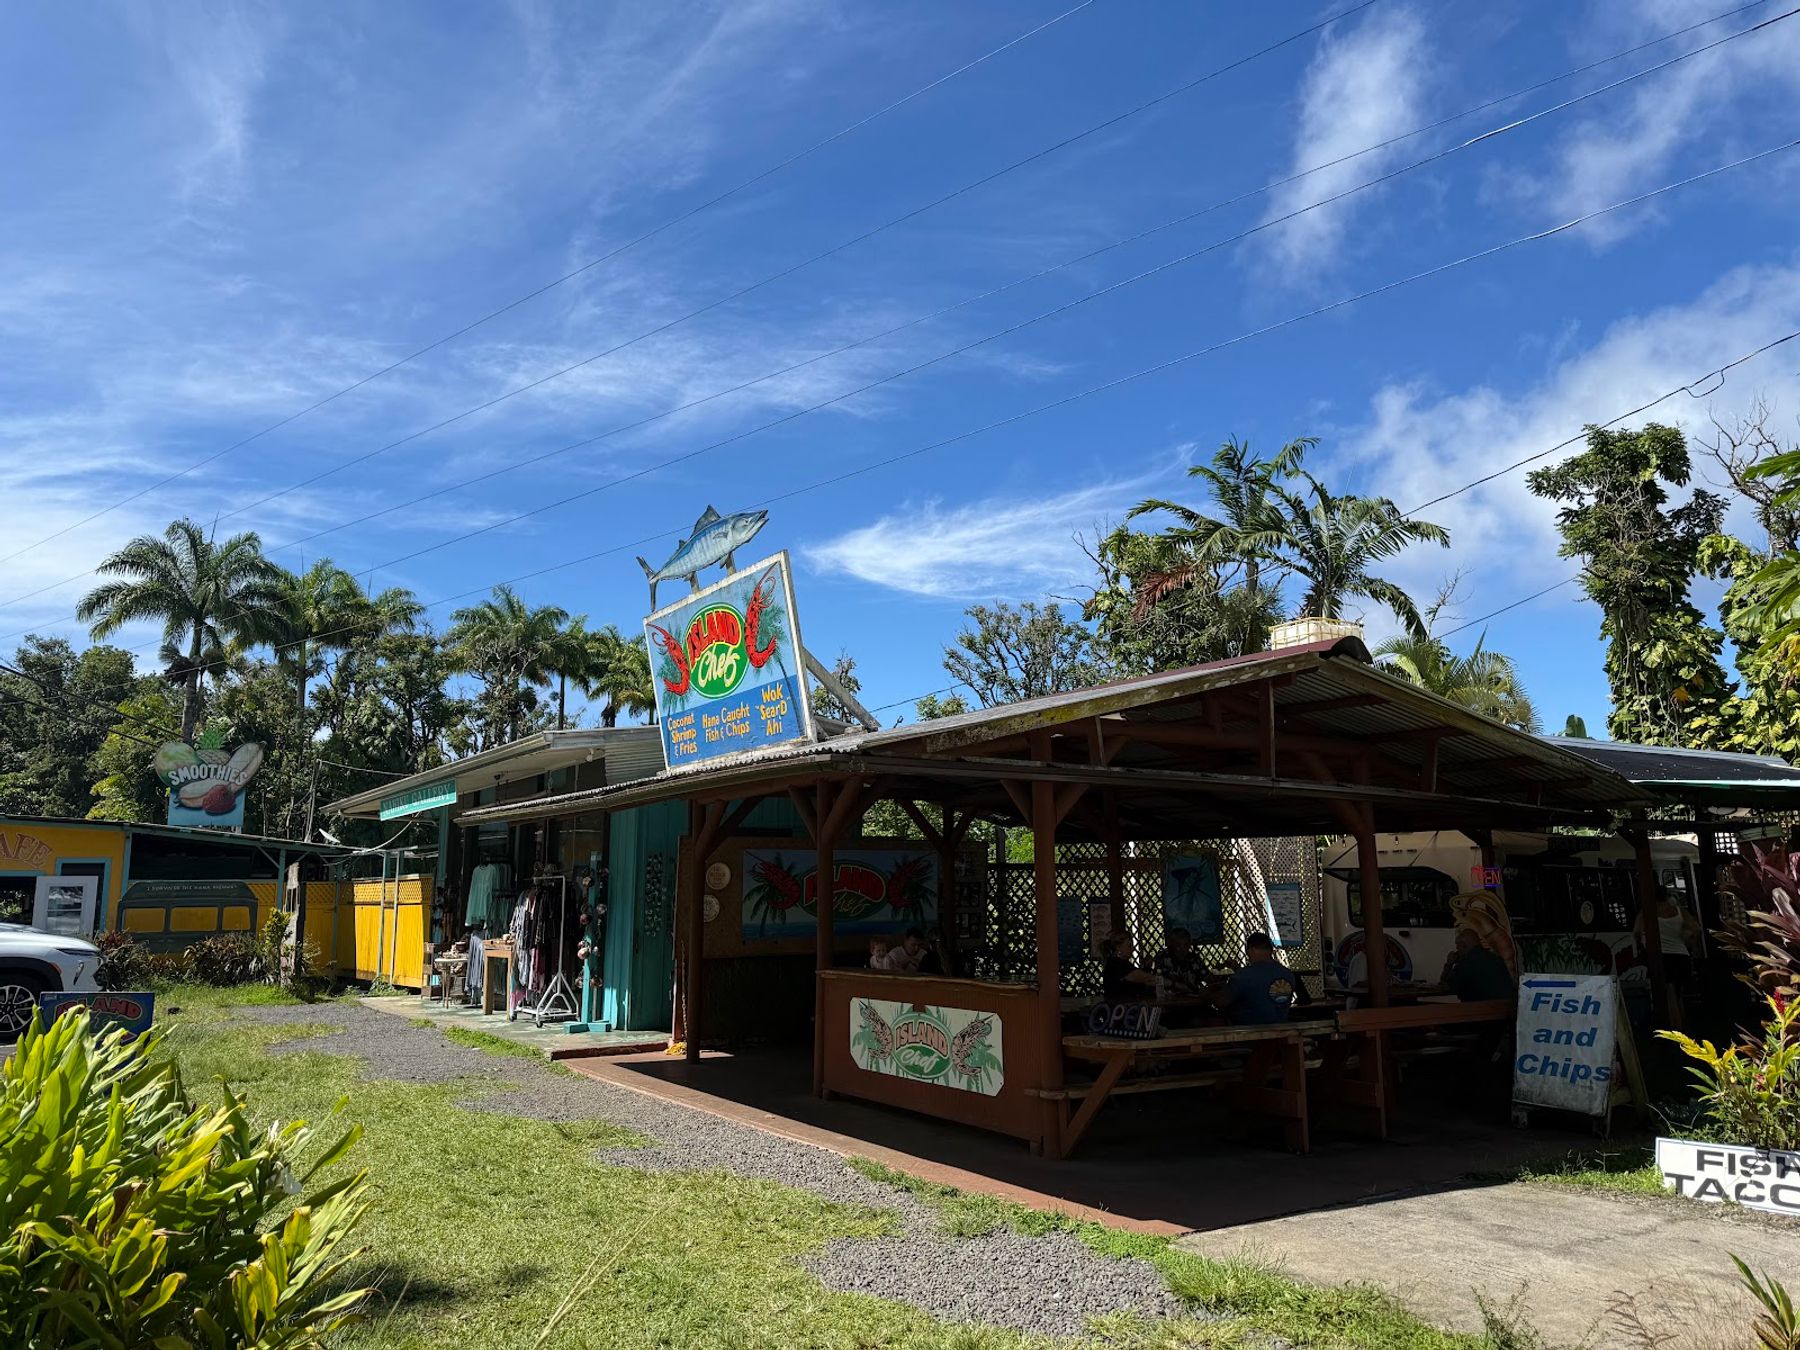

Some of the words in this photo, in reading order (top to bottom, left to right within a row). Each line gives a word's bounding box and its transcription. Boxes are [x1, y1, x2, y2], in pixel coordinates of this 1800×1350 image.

[687, 610, 741, 668] ISLAND
[667, 713, 695, 730] Coconut
[721, 702, 750, 723] Caught
[671, 727, 697, 744] Shrimp
[705, 726, 719, 743] Fish
[725, 720, 750, 738] Chips
[766, 715, 783, 737] Ahi
[679, 741, 697, 756] Fries
[168, 763, 248, 786] SMOOTHIES
[1530, 992, 1601, 1016] Fish
[1088, 1001, 1153, 1036] OPEN
[895, 1021, 948, 1057] ISLAND
[1532, 1027, 1598, 1048] and
[1516, 1053, 1611, 1085] Chips
